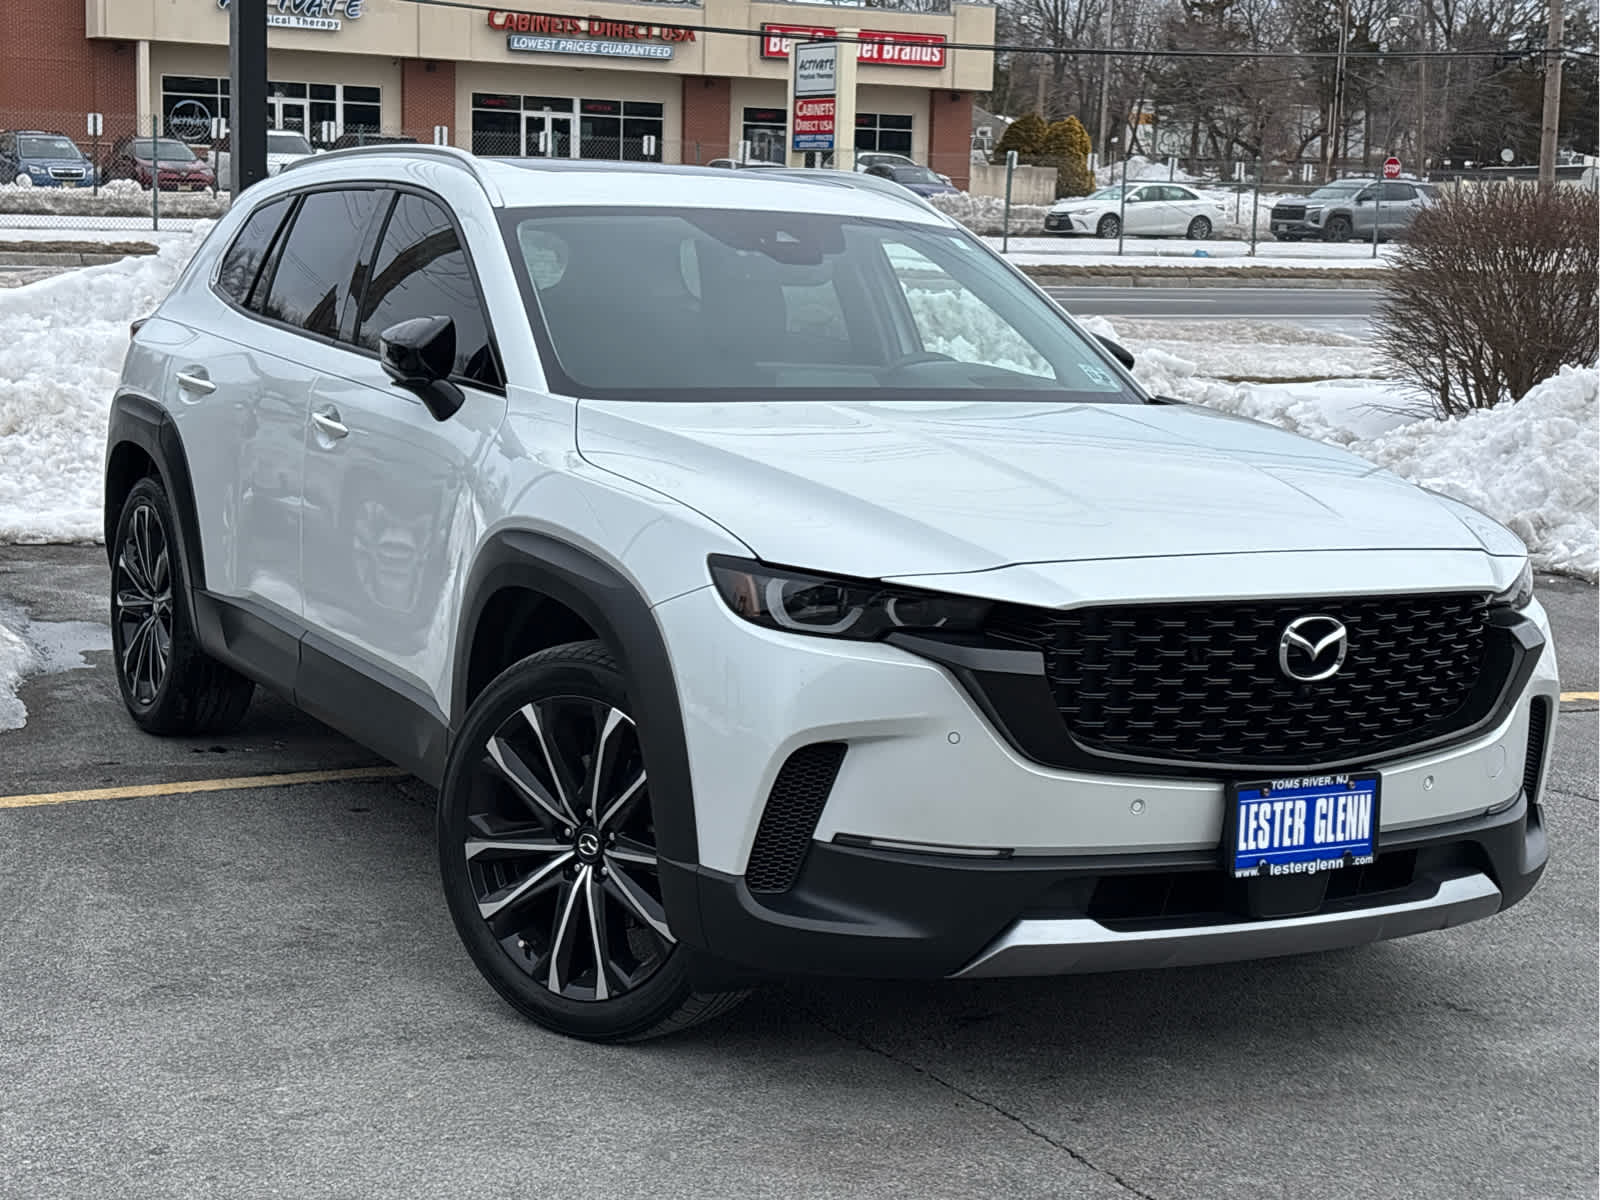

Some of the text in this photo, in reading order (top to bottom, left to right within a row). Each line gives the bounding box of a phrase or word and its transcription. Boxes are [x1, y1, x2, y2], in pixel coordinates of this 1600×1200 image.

[295, 17, 340, 29] Therapy
[488, 10, 582, 34] CABINETS
[661, 26, 697, 42] USA
[513, 38, 671, 57] LOWEST PRICES GUARANTEED
[799, 58, 834, 71] ACTIVATE
[796, 101, 834, 116] CABINETS
[795, 119, 833, 131] DIRECT USA
[1385, 164, 1400, 174] STOP
[1271, 780, 1300, 790] TOMS
[1336, 775, 1349, 785] NJ
[1238, 794, 1372, 851] LESTER GLENN
[1270, 859, 1344, 876] lesterglenn
